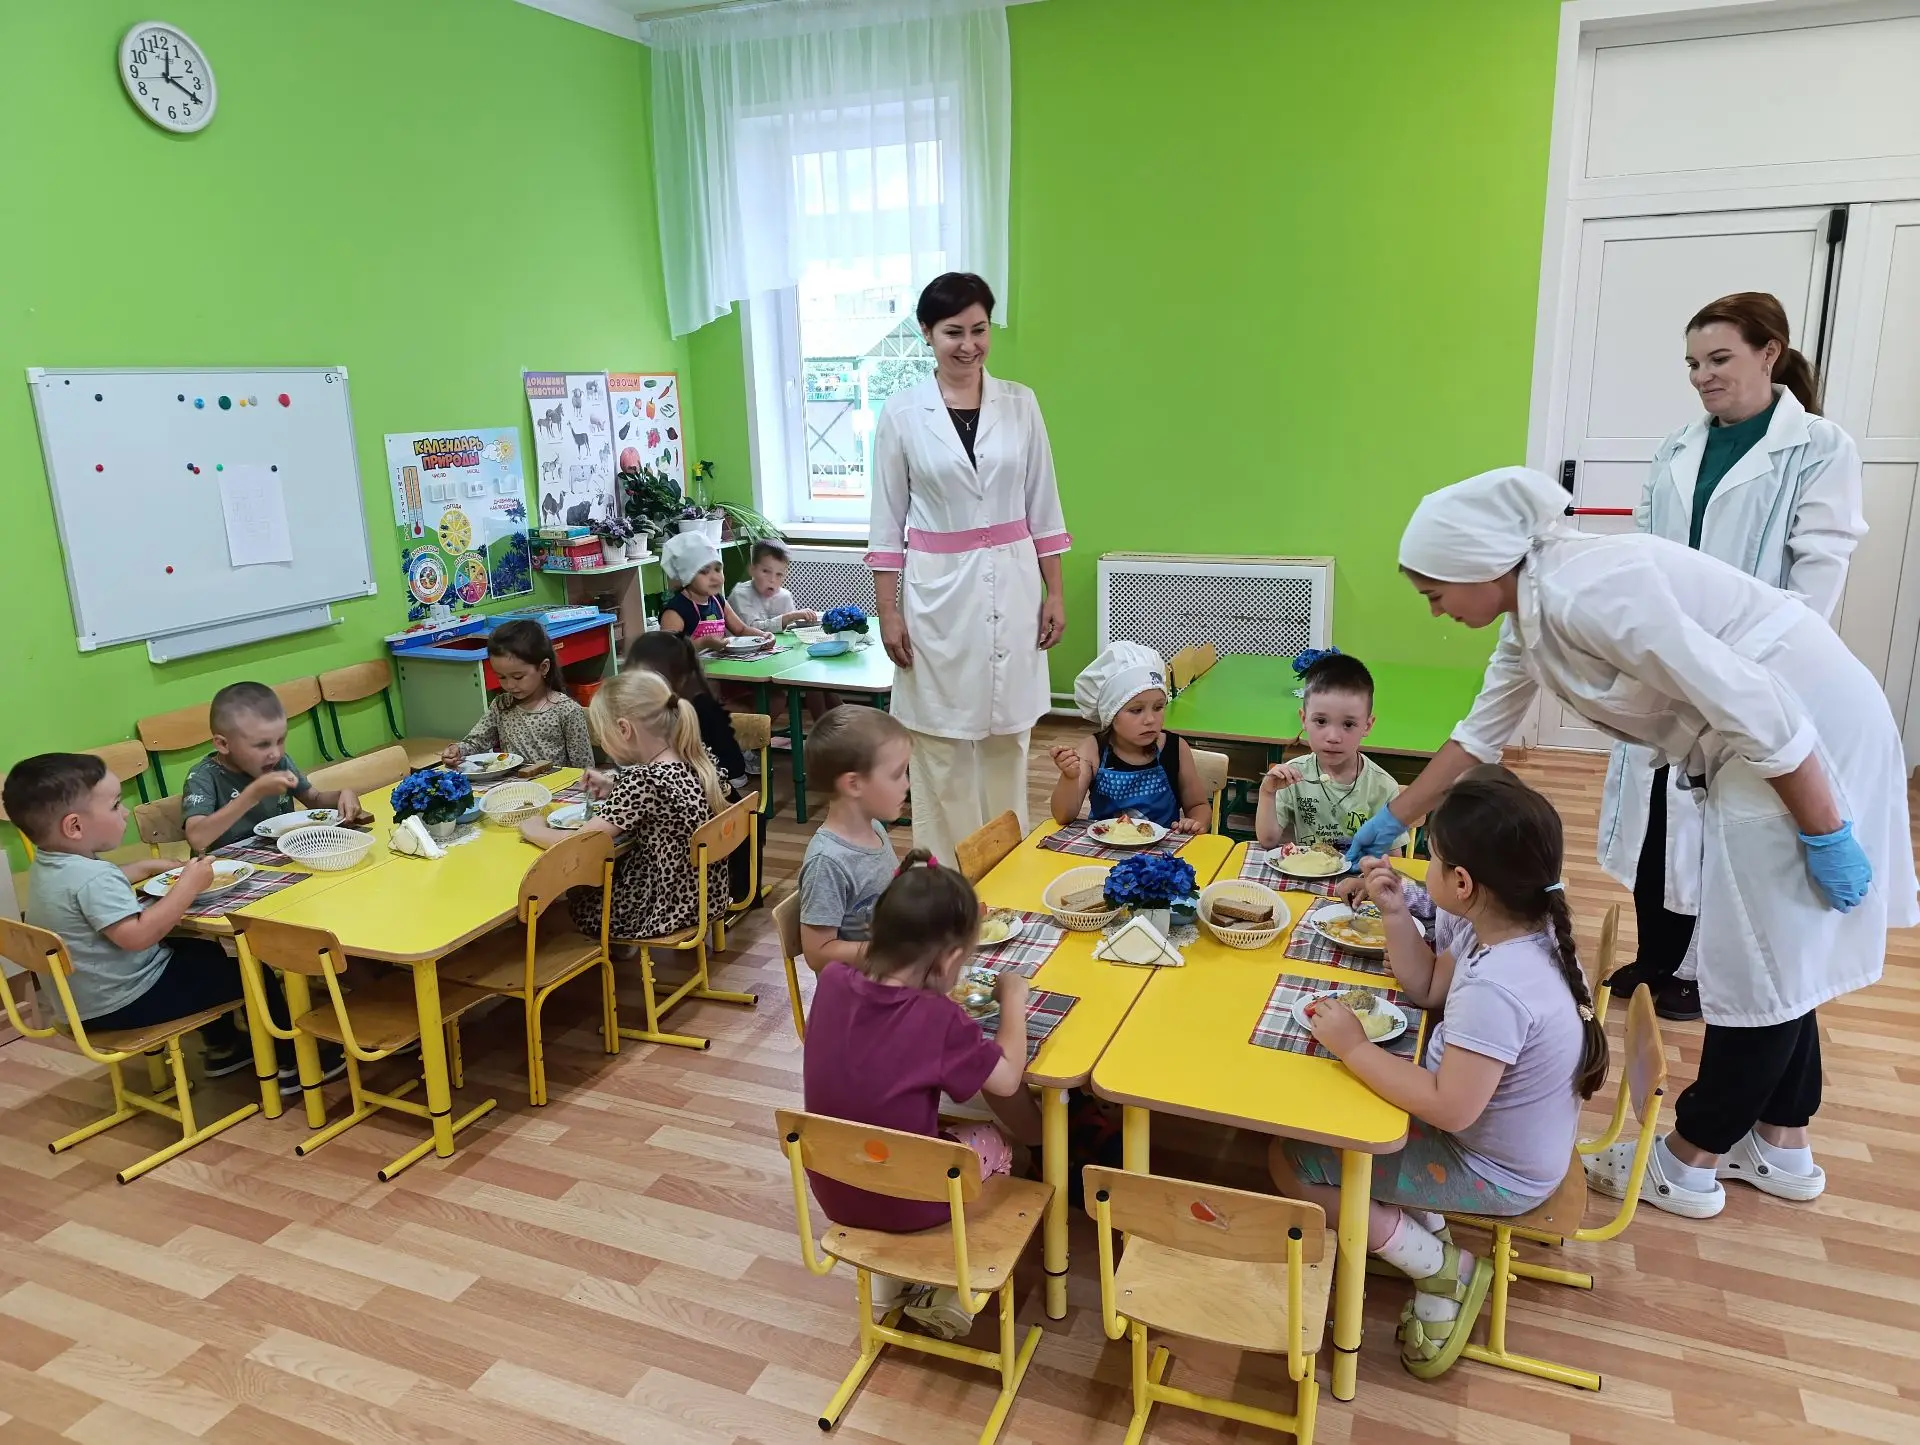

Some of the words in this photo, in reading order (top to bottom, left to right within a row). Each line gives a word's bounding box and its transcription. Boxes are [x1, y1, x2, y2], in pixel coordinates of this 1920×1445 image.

[140, 38, 156, 53] 11
[152, 35, 168, 50] 12
[131, 50, 147, 64] 10
[173, 45, 181, 58] 1
[130, 65, 138, 78] 9
[185, 60, 193, 74] 2
[138, 82, 147, 95] 8
[193, 77, 201, 90] 3
[152, 97, 160, 111] 7
[183, 103, 191, 116] 5
[168, 106, 176, 119] 6
[609, 378, 638, 387] ОВОЩИ
[413, 436, 484, 455] КАЛЕНДАРЬ
[422, 452, 480, 471] ПРИРОДЫ
[443, 503, 462, 511] ПОГОДА
